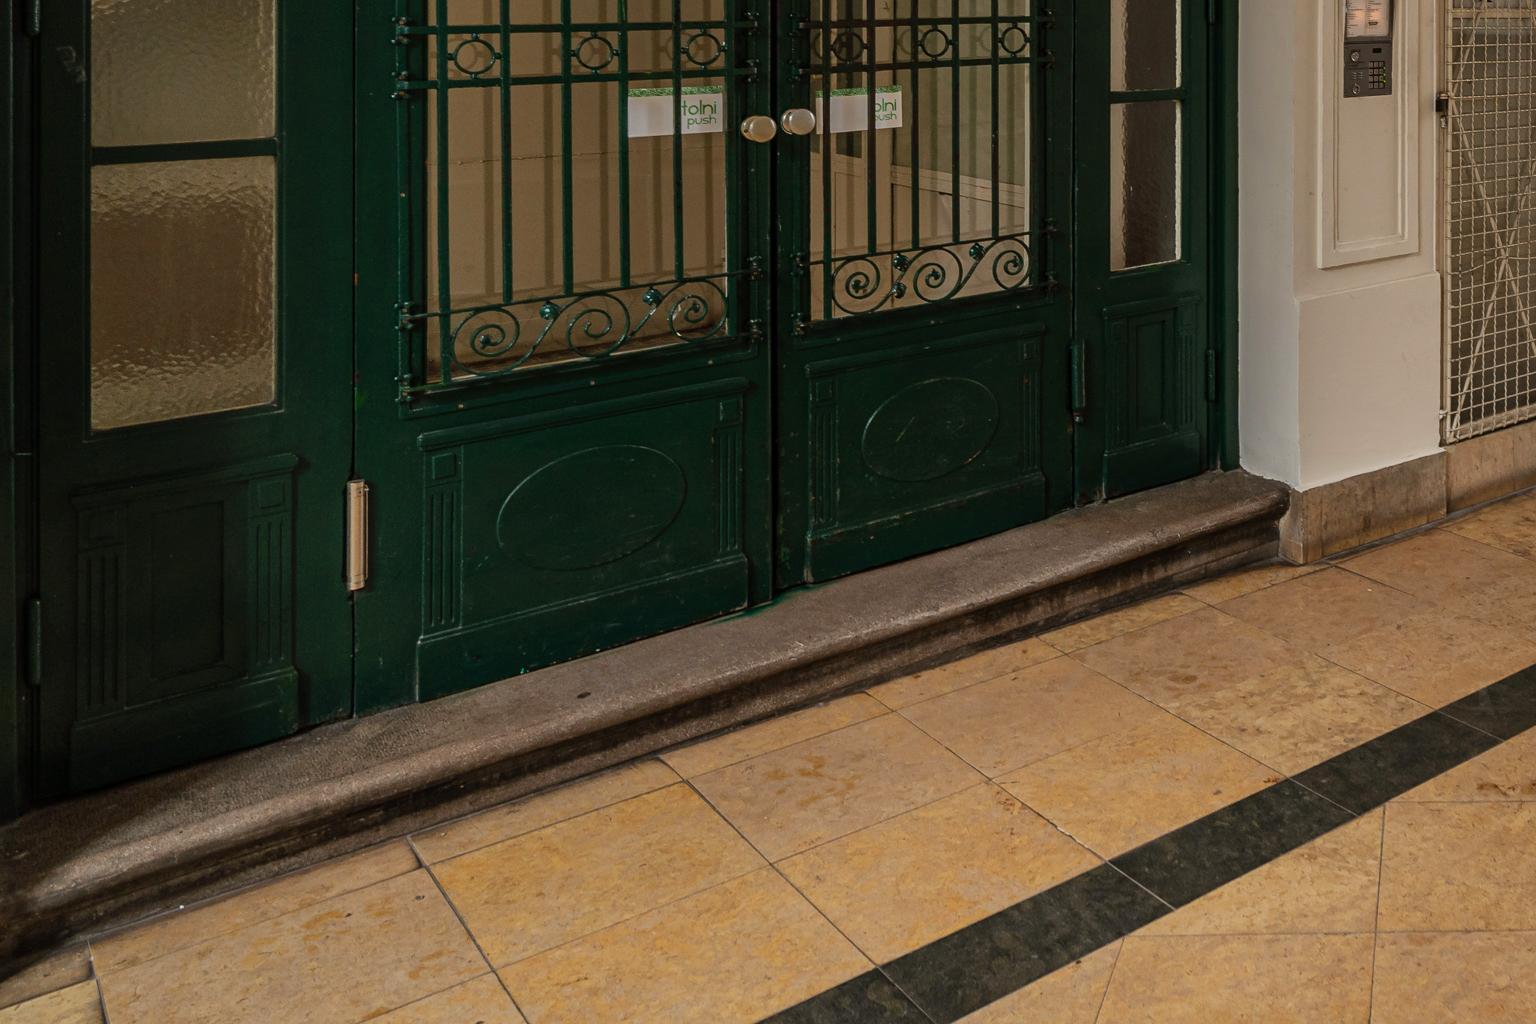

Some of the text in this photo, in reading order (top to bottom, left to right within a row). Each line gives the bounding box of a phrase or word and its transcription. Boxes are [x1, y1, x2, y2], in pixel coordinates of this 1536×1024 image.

[681, 99, 717, 116] tolni
[874, 97, 897, 113] olni
[687, 114, 717, 130] push
